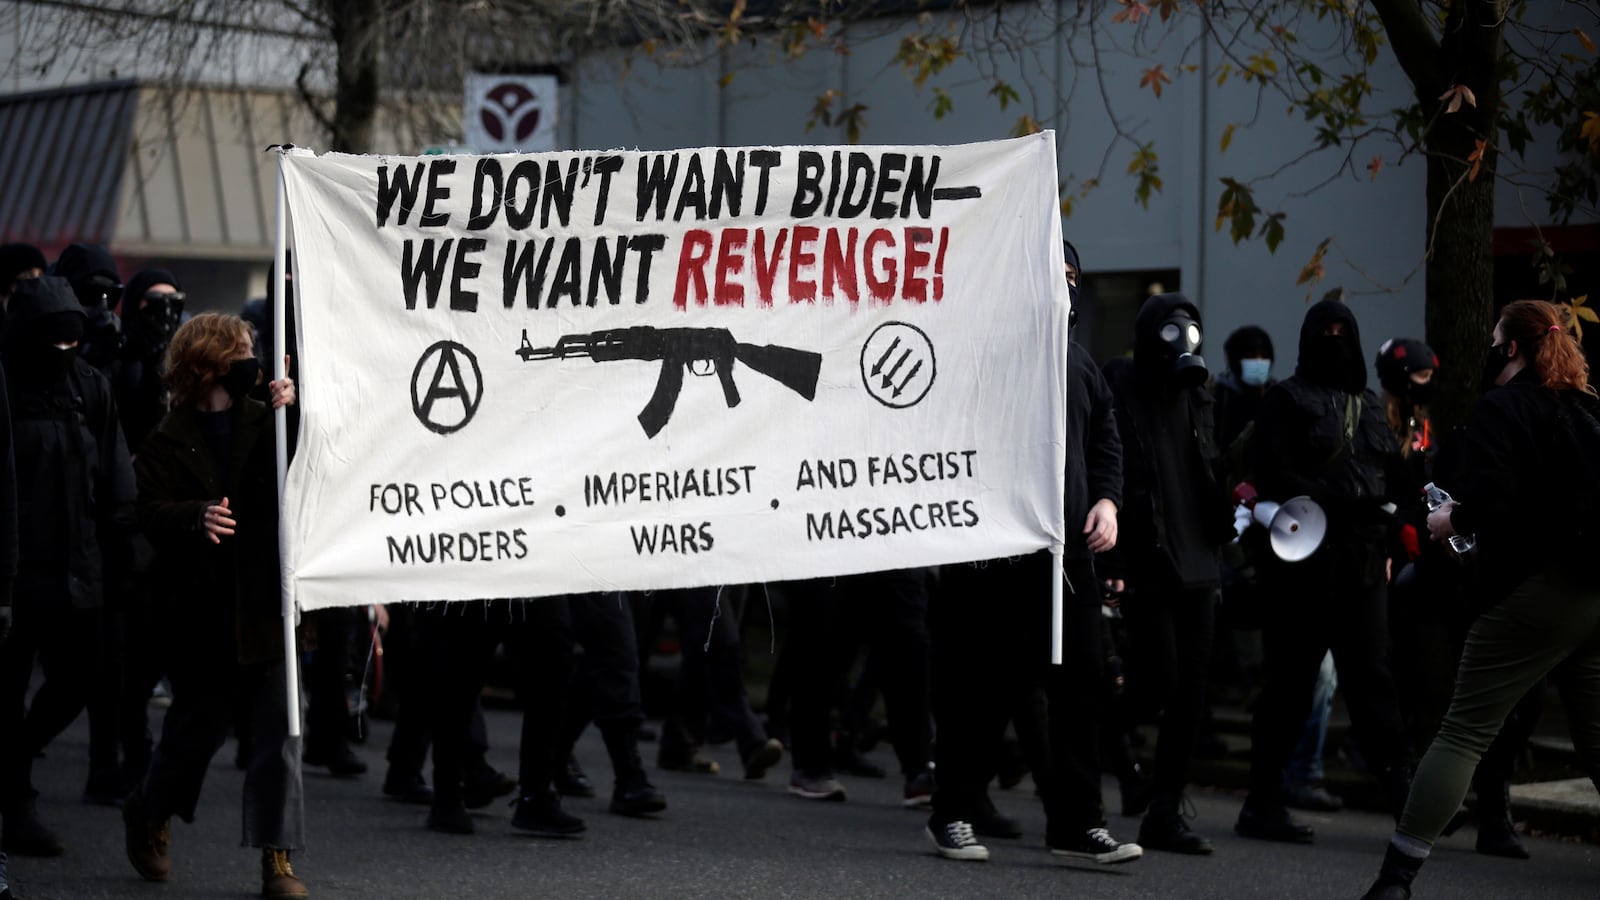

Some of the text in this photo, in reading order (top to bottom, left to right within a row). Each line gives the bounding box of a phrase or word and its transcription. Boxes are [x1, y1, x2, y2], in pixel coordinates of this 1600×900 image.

[376, 159, 457, 228] WE
[466, 153, 625, 231] DON'T
[636, 149, 782, 222] WANT
[401, 225, 949, 313] WE WANT REVENGE!
[585, 465, 756, 507] IMPERIALIST
[797, 449, 978, 491] AND FASCIST
[370, 475, 535, 517] FOR POLICE
[630, 521, 714, 556] WARS
[807, 499, 979, 541] MASSACRES
[387, 530, 528, 565] MURDERS
